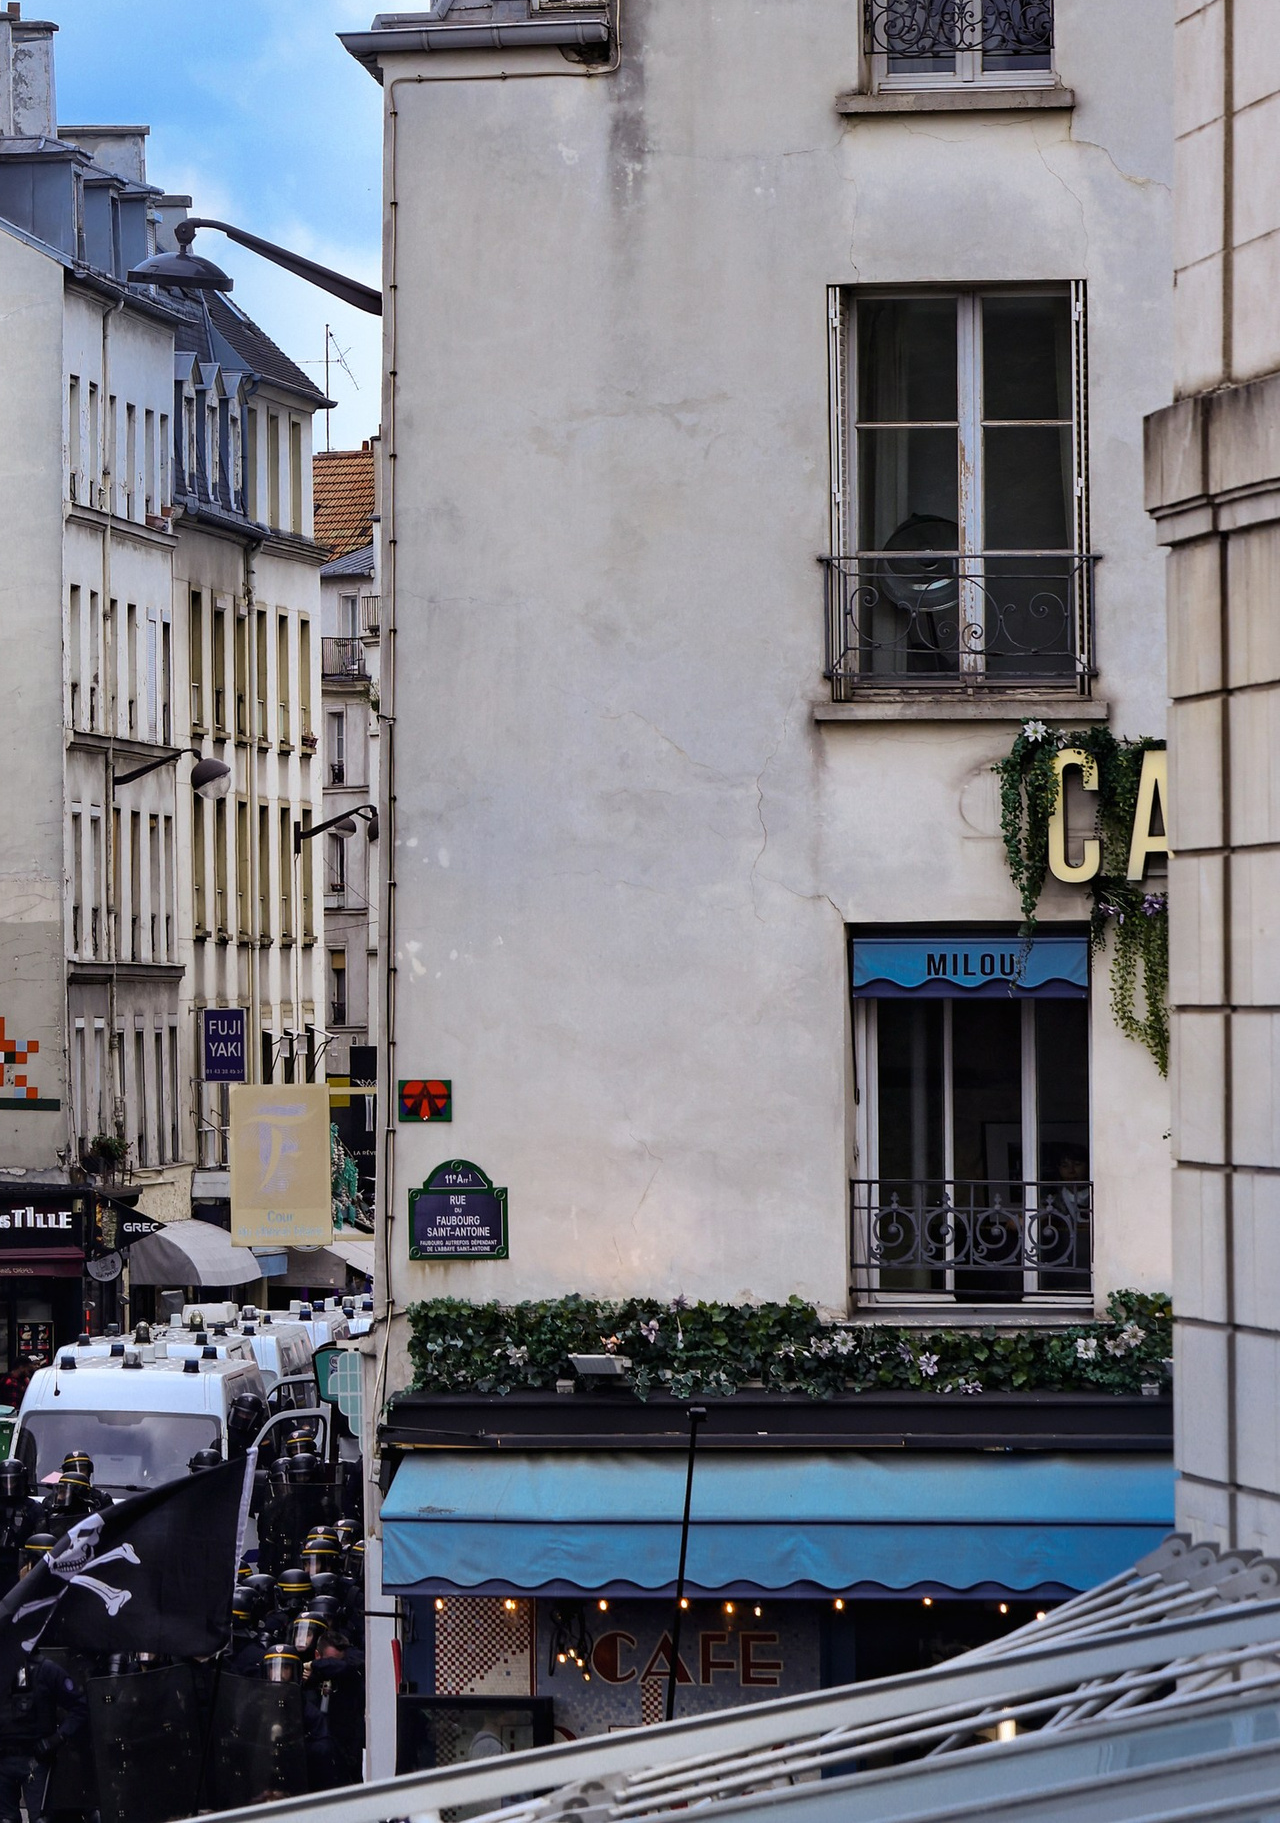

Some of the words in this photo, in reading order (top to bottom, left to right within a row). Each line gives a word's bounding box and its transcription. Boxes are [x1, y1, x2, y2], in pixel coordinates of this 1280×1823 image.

[926, 953, 1016, 976] MILOU
[209, 1020, 241, 1035] FUJI
[209, 1042, 241, 1057] YAKI
[450, 1195, 466, 1205] RUE
[436, 1215, 480, 1225] FAUBOURG
[123, 1222, 159, 1233] GREC
[427, 1227, 490, 1237] SAINT-ANTOINE
[591, 1630, 784, 1687] CAFE
